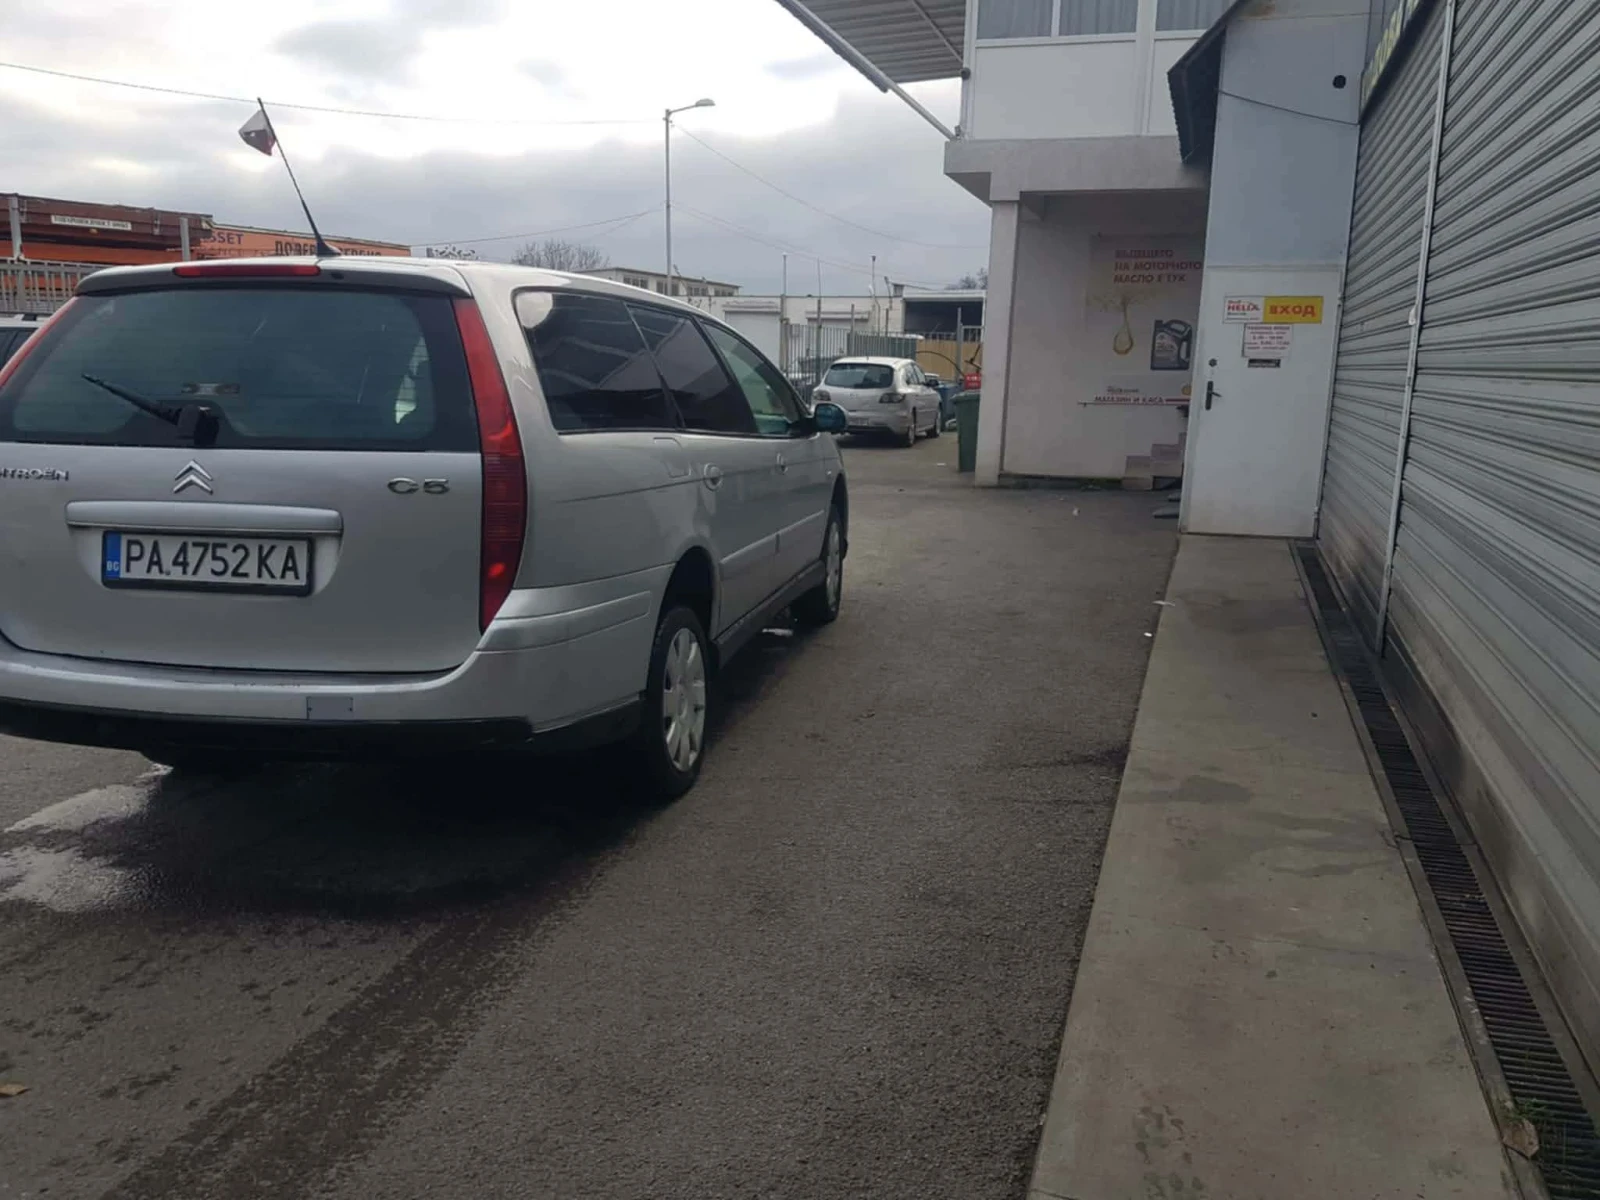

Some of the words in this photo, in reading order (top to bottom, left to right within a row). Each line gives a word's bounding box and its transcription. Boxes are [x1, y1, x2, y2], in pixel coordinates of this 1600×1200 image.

[1269, 305, 1317, 317] ВХОД
[0, 466, 69, 481] ITROËN
[387, 477, 450, 495] C5
[106, 560, 120, 571] BG
